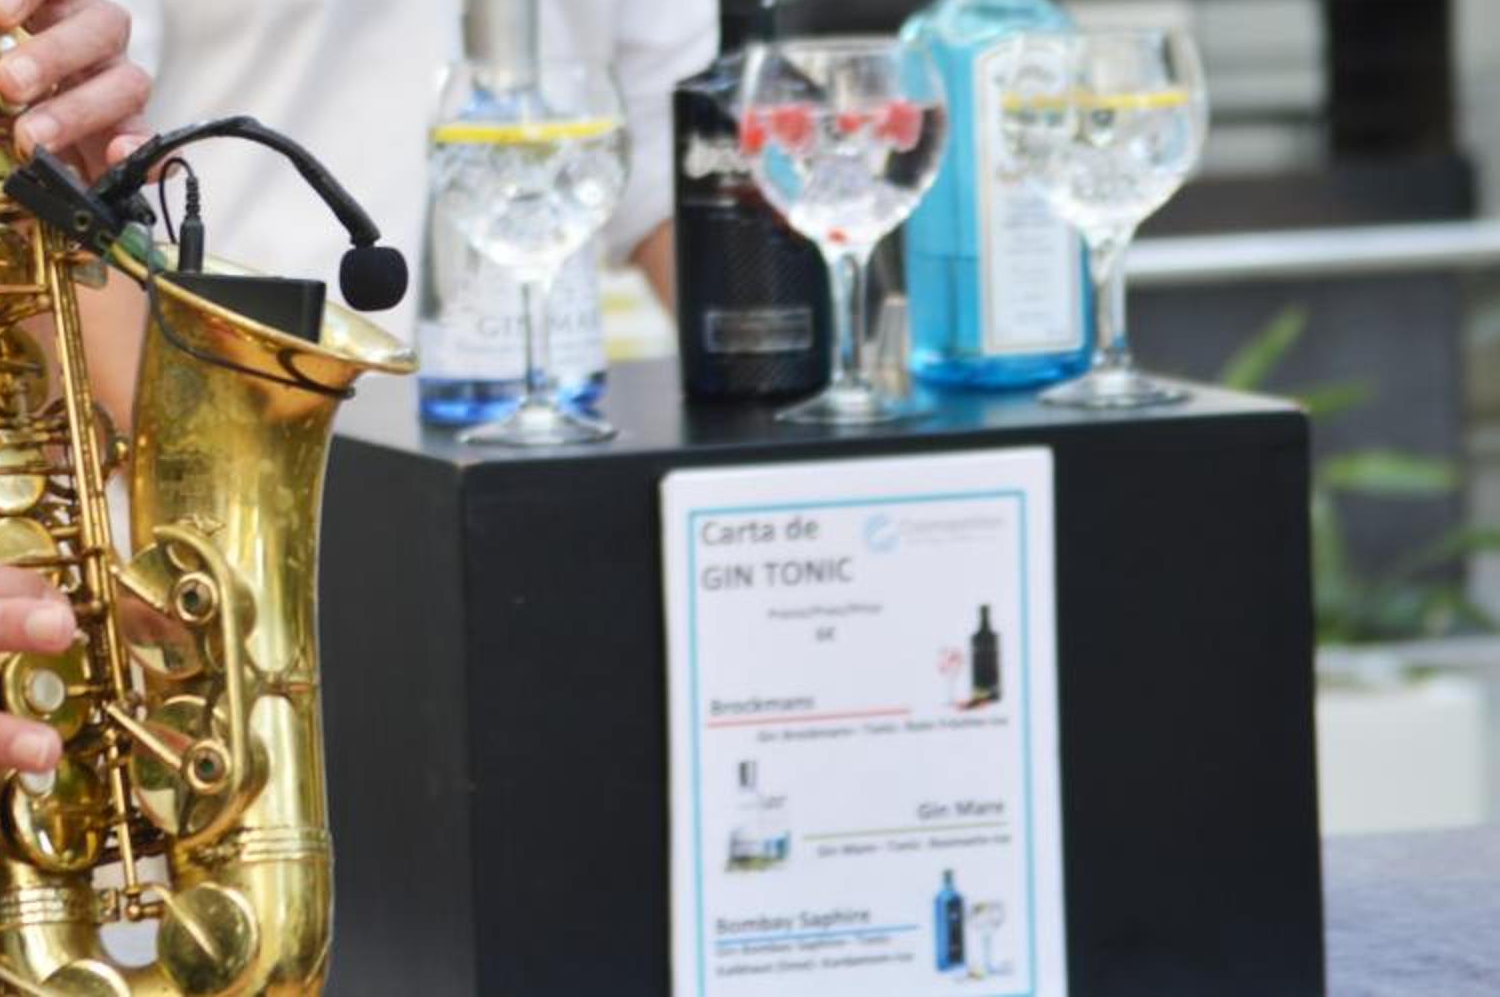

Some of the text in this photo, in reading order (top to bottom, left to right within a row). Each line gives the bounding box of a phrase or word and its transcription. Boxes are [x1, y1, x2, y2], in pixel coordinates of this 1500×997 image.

[702, 515, 820, 546] Carta de
[702, 556, 854, 591] GIN TONIC
[917, 802, 949, 820] Gin
[716, 912, 794, 935] Bombay
